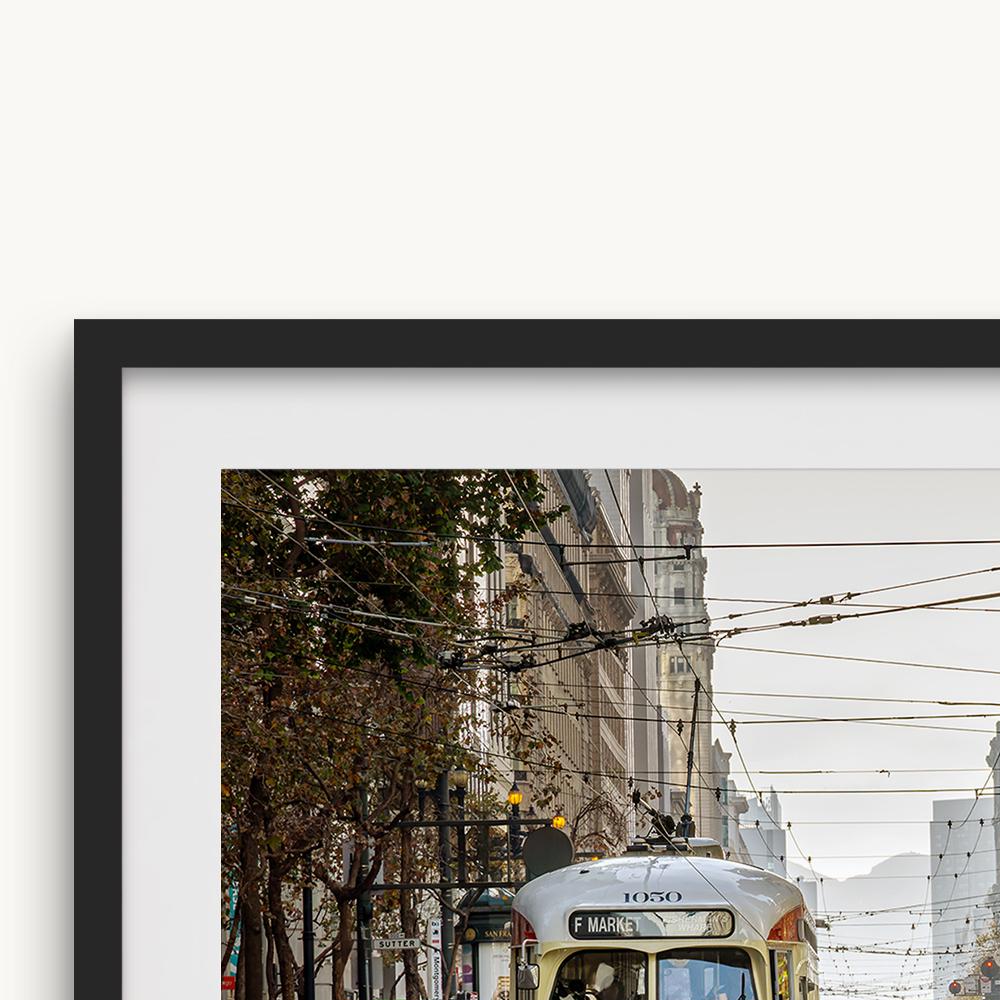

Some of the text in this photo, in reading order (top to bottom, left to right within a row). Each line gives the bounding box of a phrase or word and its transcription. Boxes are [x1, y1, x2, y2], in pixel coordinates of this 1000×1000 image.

[623, 890, 683, 904] 1050
[574, 916, 641, 933] F MARKET
[379, 940, 416, 948] SUTTER
